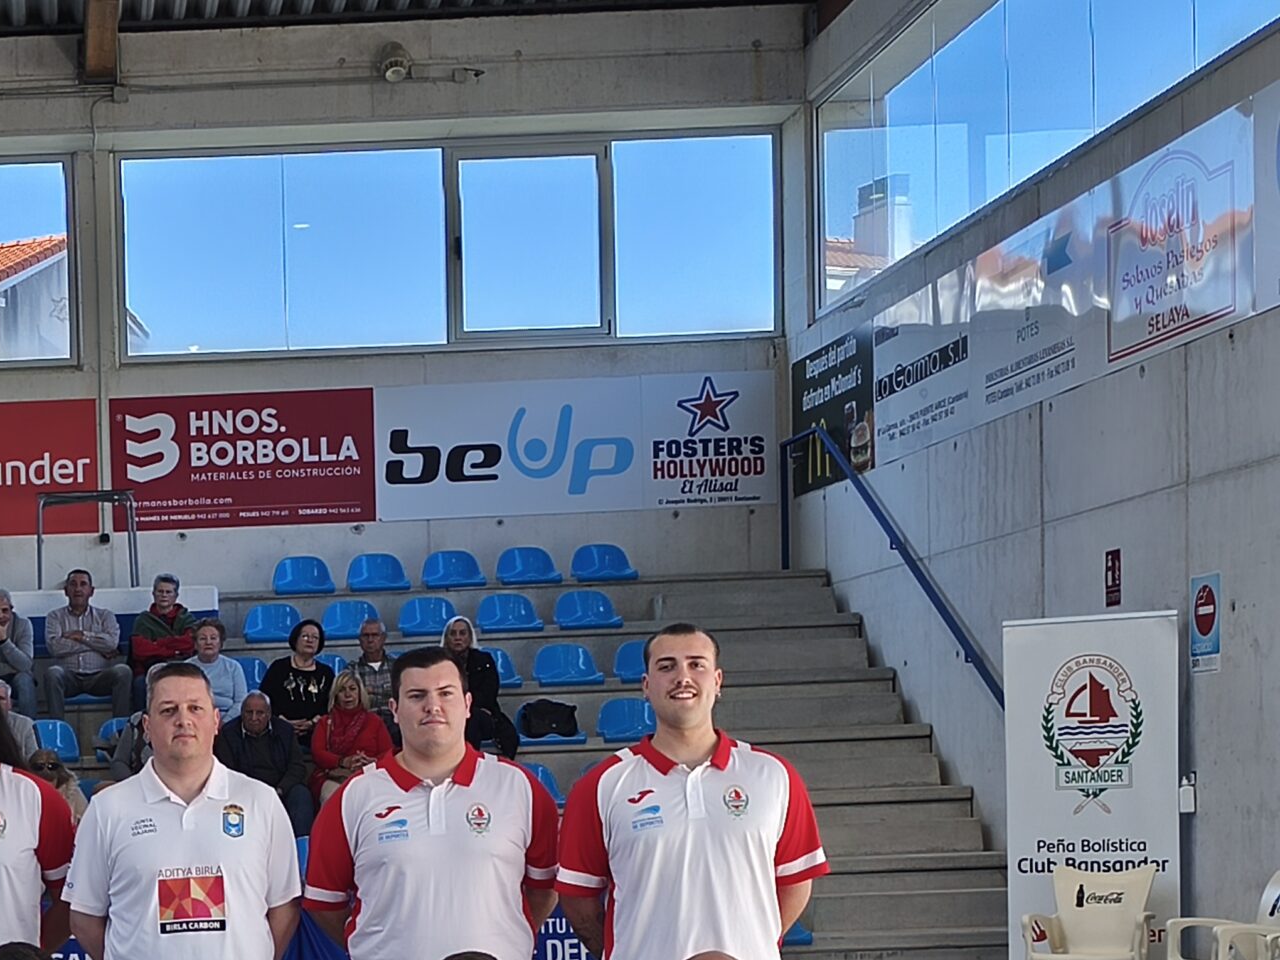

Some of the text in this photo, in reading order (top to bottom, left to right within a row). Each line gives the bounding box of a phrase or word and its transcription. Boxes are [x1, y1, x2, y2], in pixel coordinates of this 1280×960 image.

[1122, 234, 1218, 290] Sobaos Pasiegos
[1148, 304, 1190, 335] SELAYA
[1017, 320, 1039, 343] POTES
[189, 408, 287, 436] HNOS.
[190, 435, 360, 467] BORBOLLA
[652, 435, 765, 460] FOSTER'S
[190, 465, 361, 482] MATERIALES DE CONSTRUCCIÓN
[653, 456, 765, 480] HOLLYWOOD
[680, 479, 739, 494] El Alisal
[1054, 657, 1128, 689] CLUB BANSANDER
[1064, 769, 1124, 785] SANTANDER
[1037, 838, 1147, 853] Peña Bolística
[158, 865, 223, 878] ADITYA BIRLA
[1017, 858, 1058, 874] Club
[166, 921, 220, 931] BIRLA CARBON
